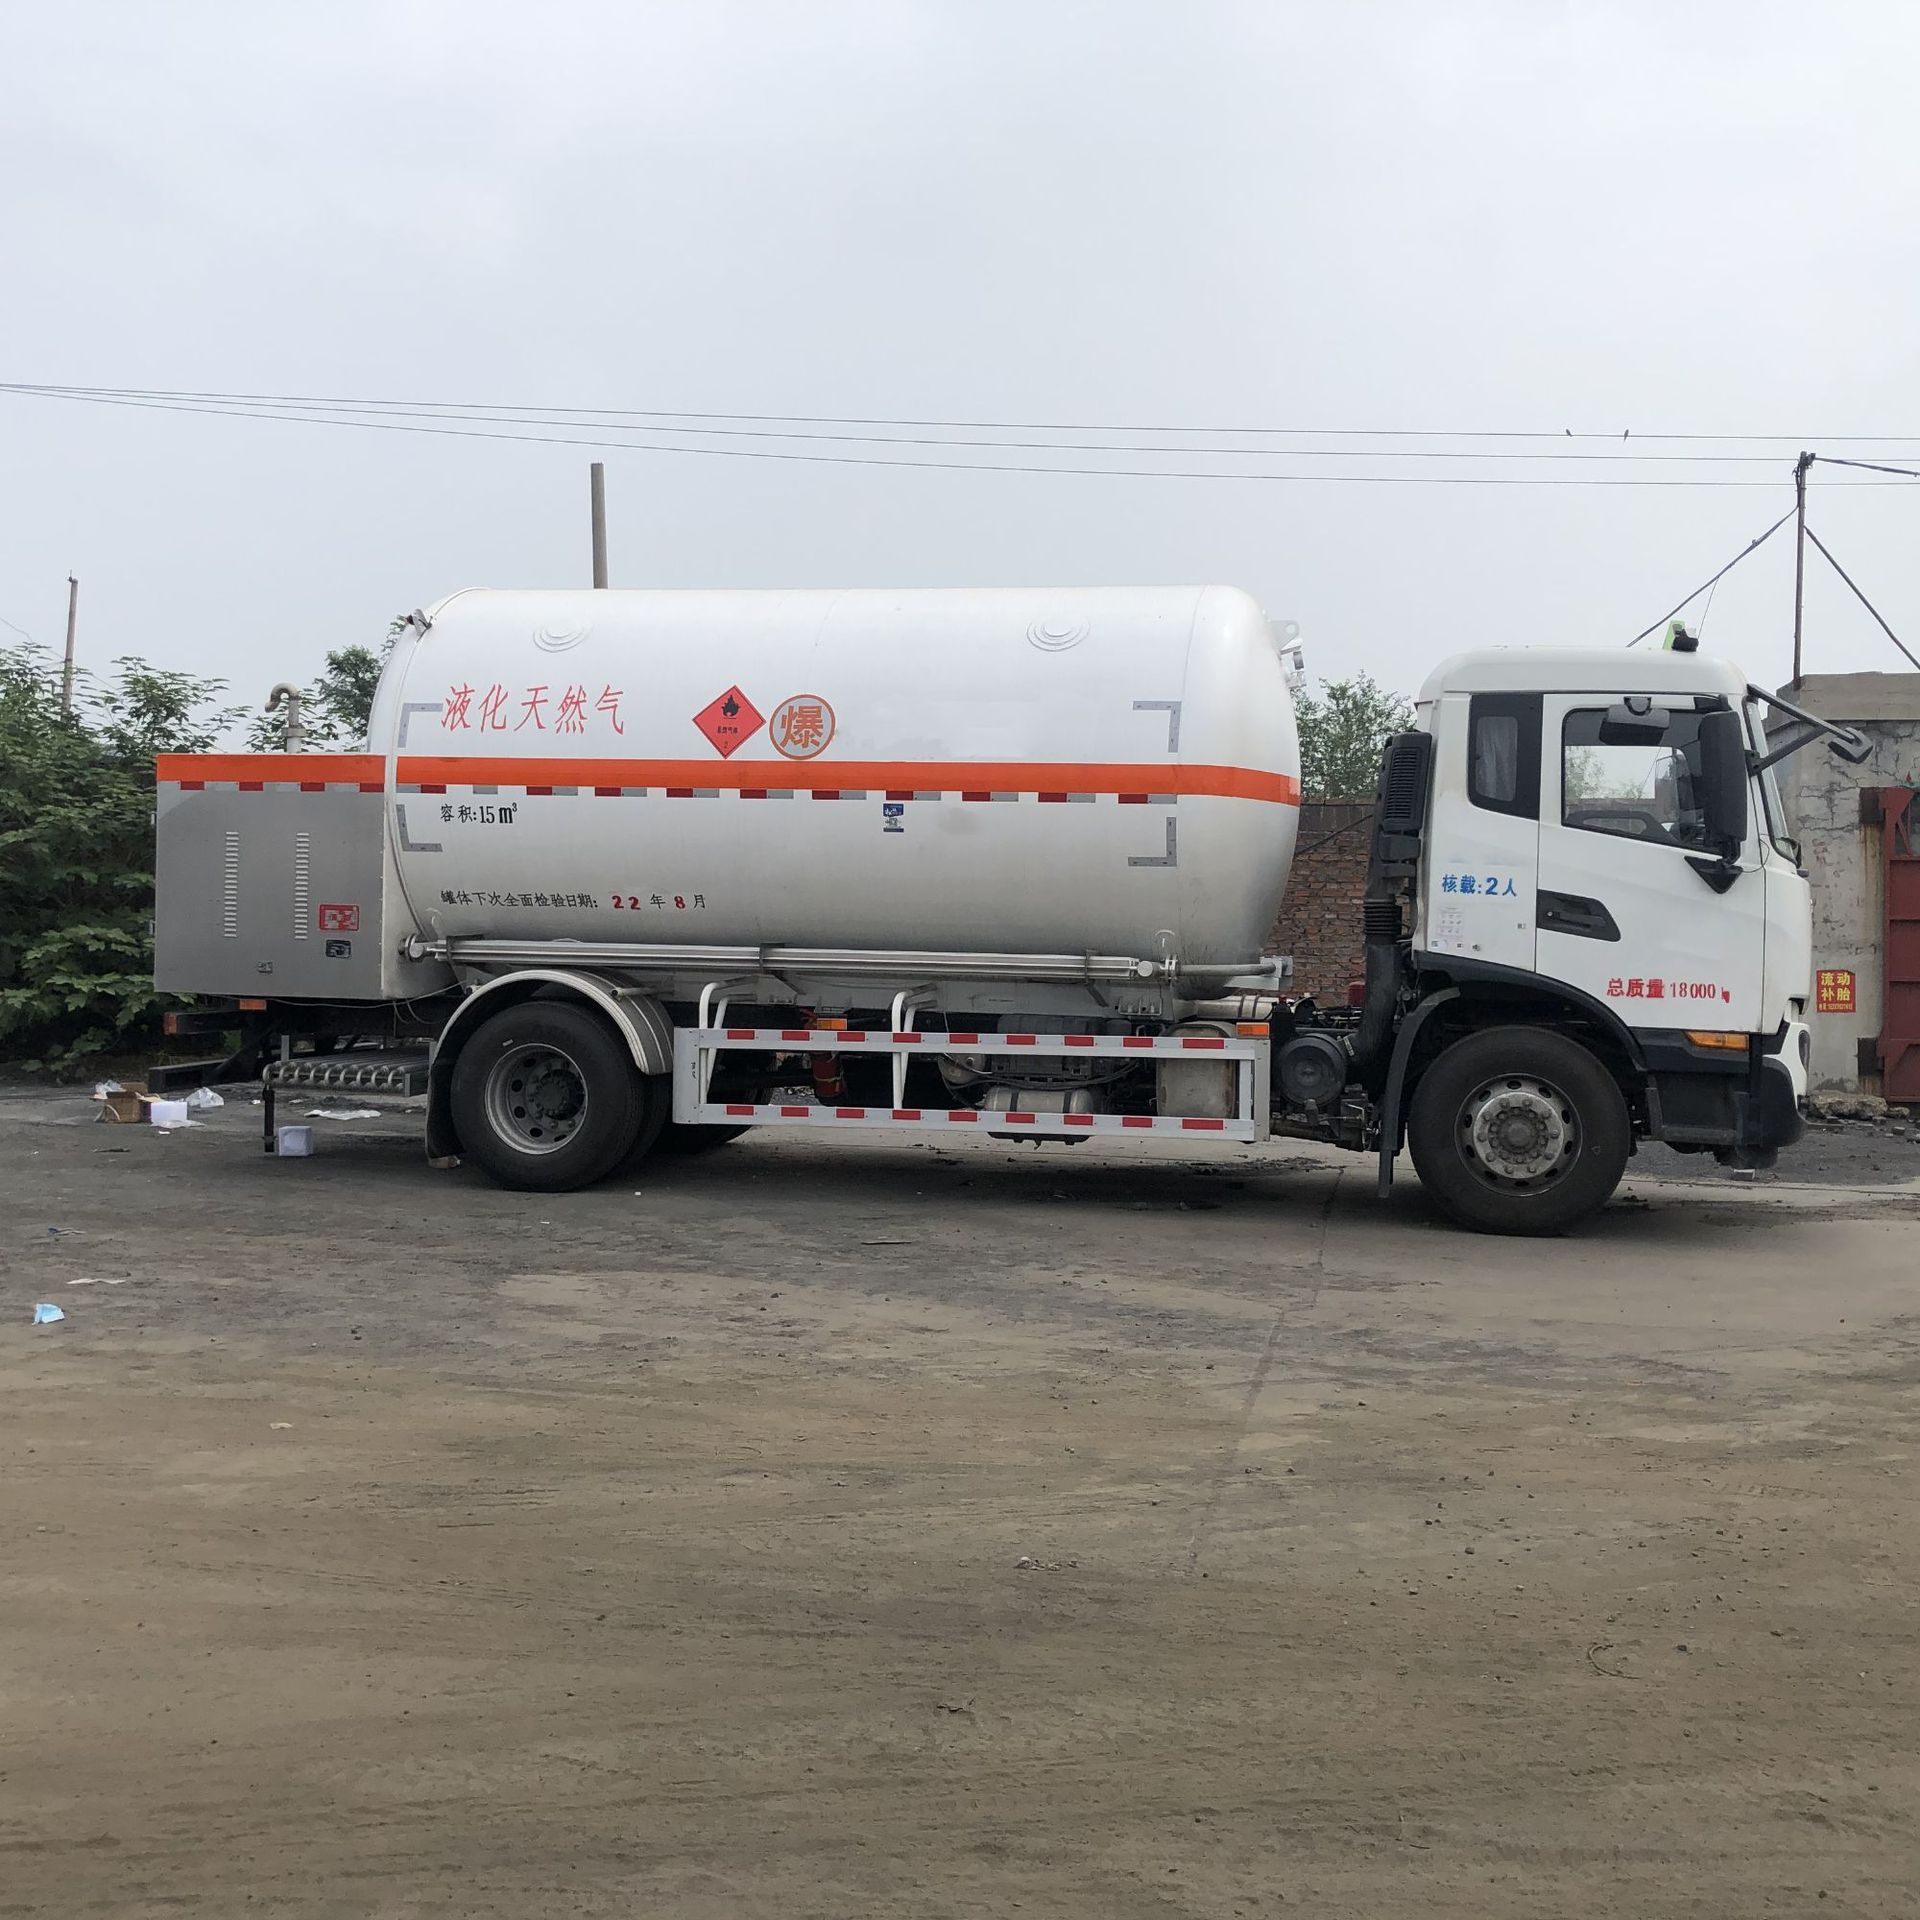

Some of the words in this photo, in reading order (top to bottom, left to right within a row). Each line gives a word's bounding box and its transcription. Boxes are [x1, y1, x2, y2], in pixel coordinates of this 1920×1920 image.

[441, 682, 624, 735] 液化天然气
[780, 705, 823, 748] 爆
[1441, 874, 1517, 897] 核载:2人
[1821, 972, 1850, 986] 流动
[1821, 987, 1851, 1001] 补胎
